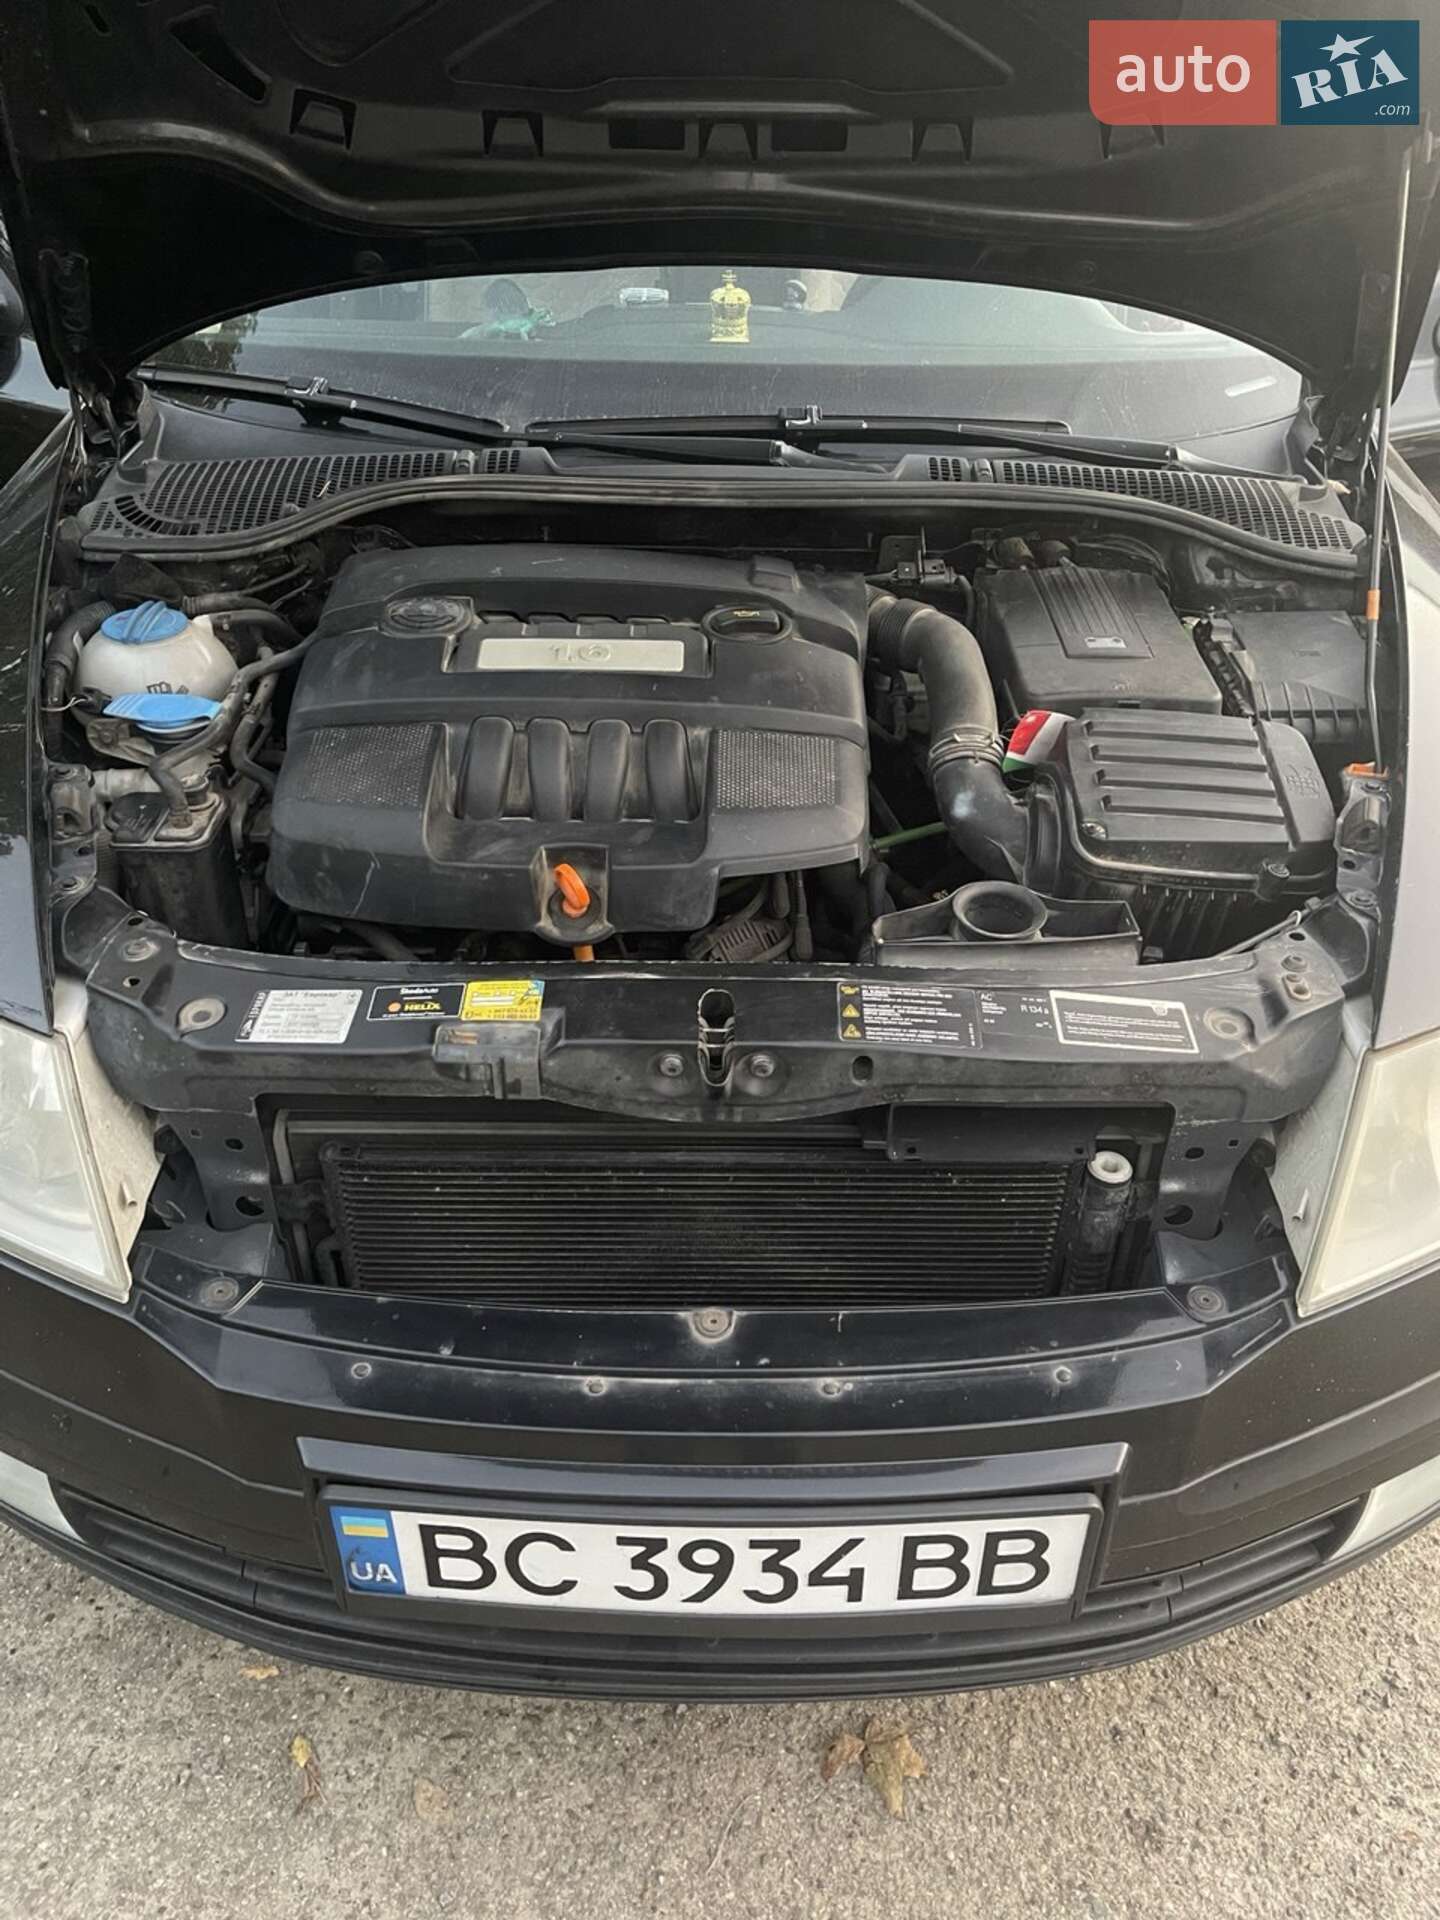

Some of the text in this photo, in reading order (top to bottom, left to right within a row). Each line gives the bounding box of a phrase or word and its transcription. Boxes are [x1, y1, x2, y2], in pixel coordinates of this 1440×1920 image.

[403, 1001, 441, 1012] HELIX
[350, 1560, 397, 1584] UA
[418, 1523, 1051, 1603] BC 3934 BB
